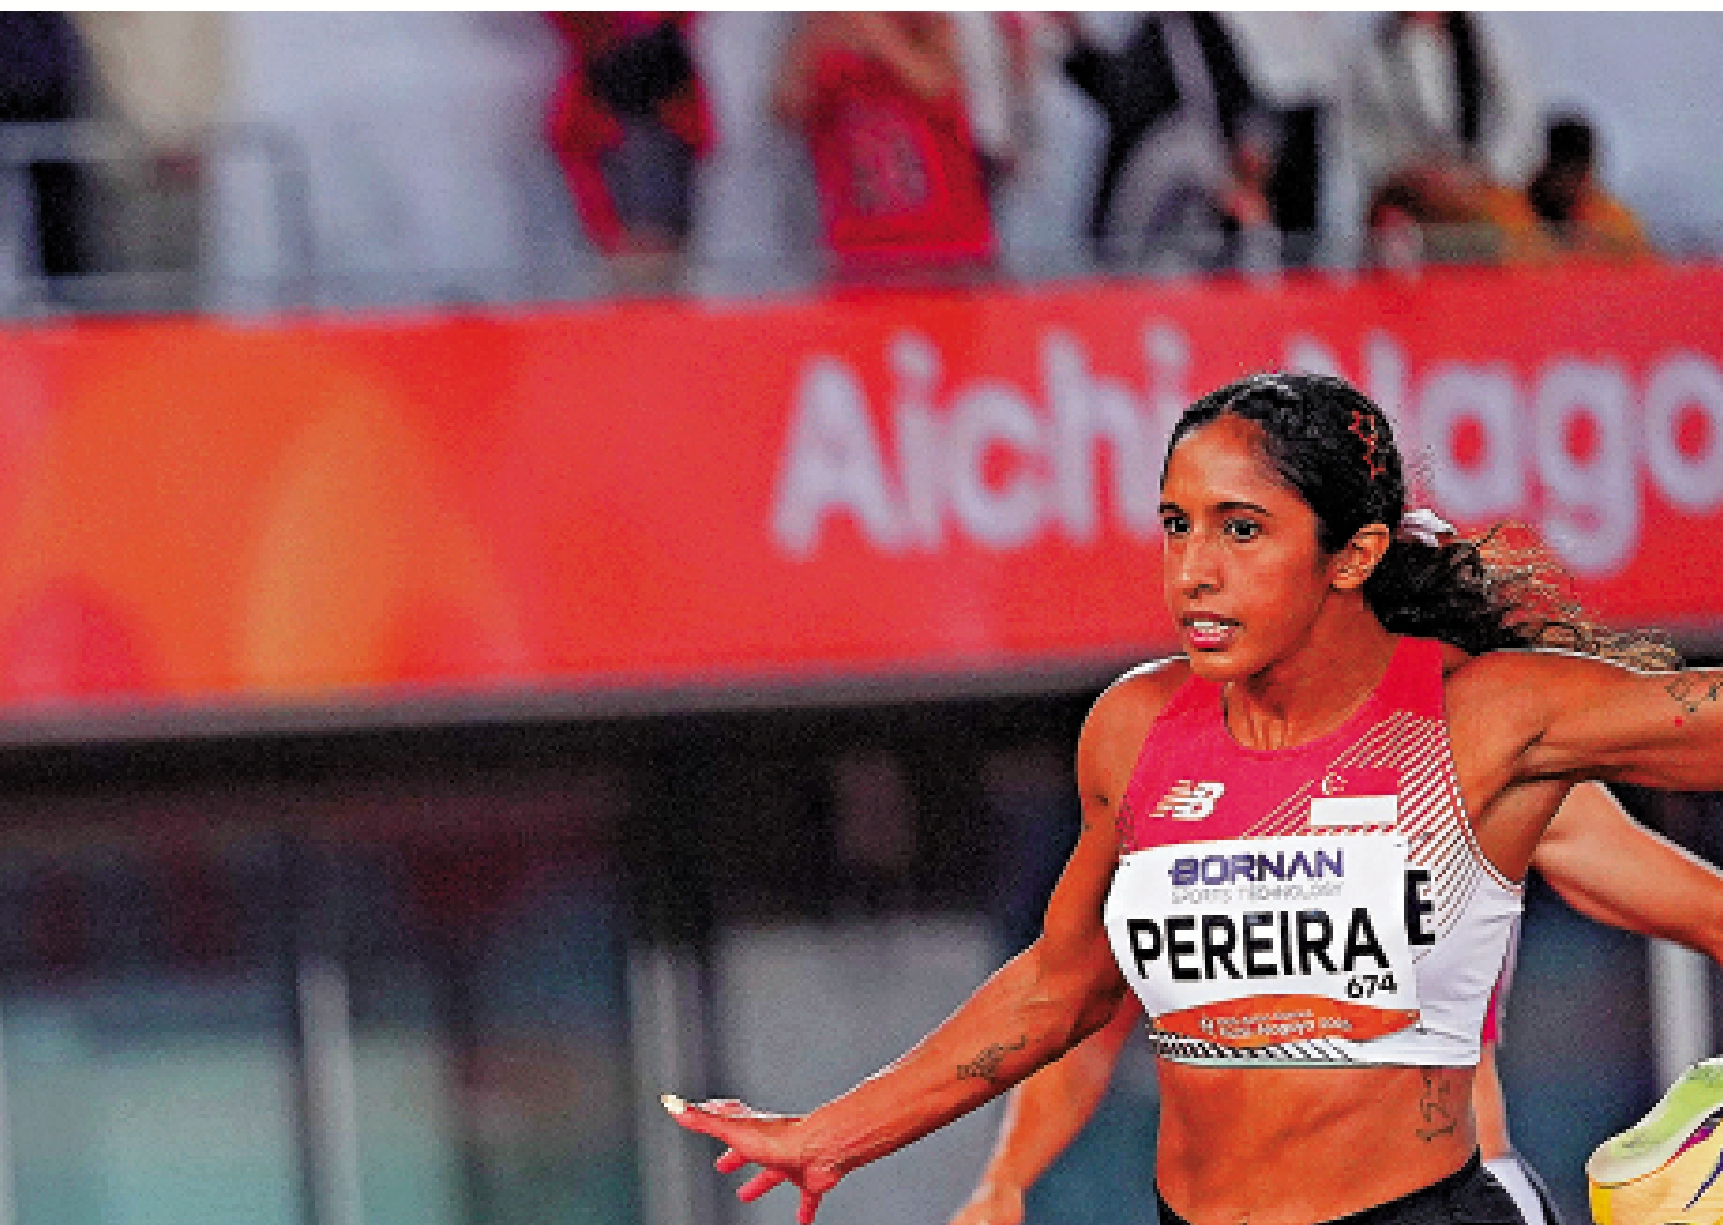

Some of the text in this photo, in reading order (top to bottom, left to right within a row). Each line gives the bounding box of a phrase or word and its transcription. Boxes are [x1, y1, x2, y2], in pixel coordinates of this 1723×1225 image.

[1168, 849, 1345, 885] BORNAN
[1127, 907, 1390, 981] PEREIRA
[1346, 973, 1398, 999] 674
